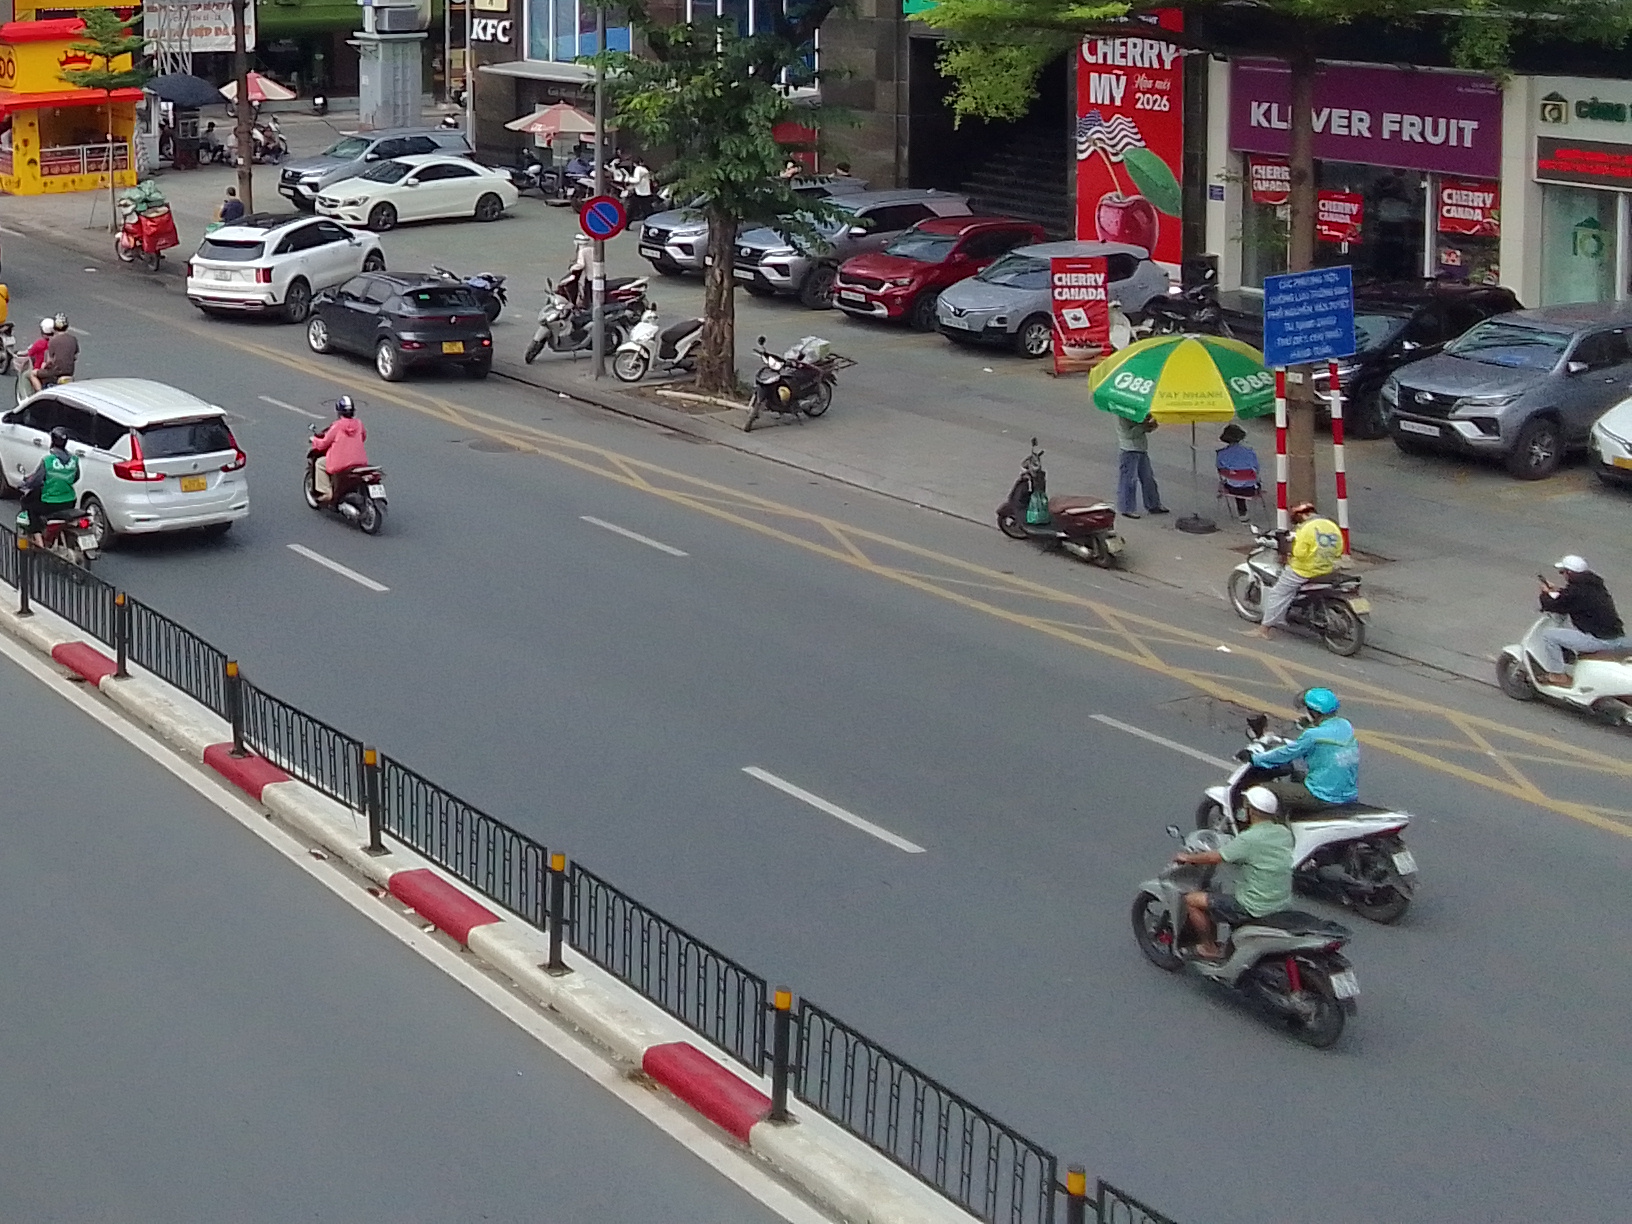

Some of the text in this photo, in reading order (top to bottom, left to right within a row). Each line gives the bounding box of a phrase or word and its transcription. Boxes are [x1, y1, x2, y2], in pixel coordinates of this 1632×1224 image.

[471, 17, 512, 43] KFC
[1082, 36, 1177, 69] CHERRY
[1089, 69, 1127, 107] MỸ
[1135, 92, 1170, 111] 2026
[1250, 101, 1479, 148] KLVER FRUIT
[1318, 199, 1360, 215] CHERRY
[1442, 188, 1494, 208] CHERRY
[1054, 273, 1105, 286] CHERRY
[1054, 287, 1106, 300] CANADA
[1114, 371, 1154, 394] F88
